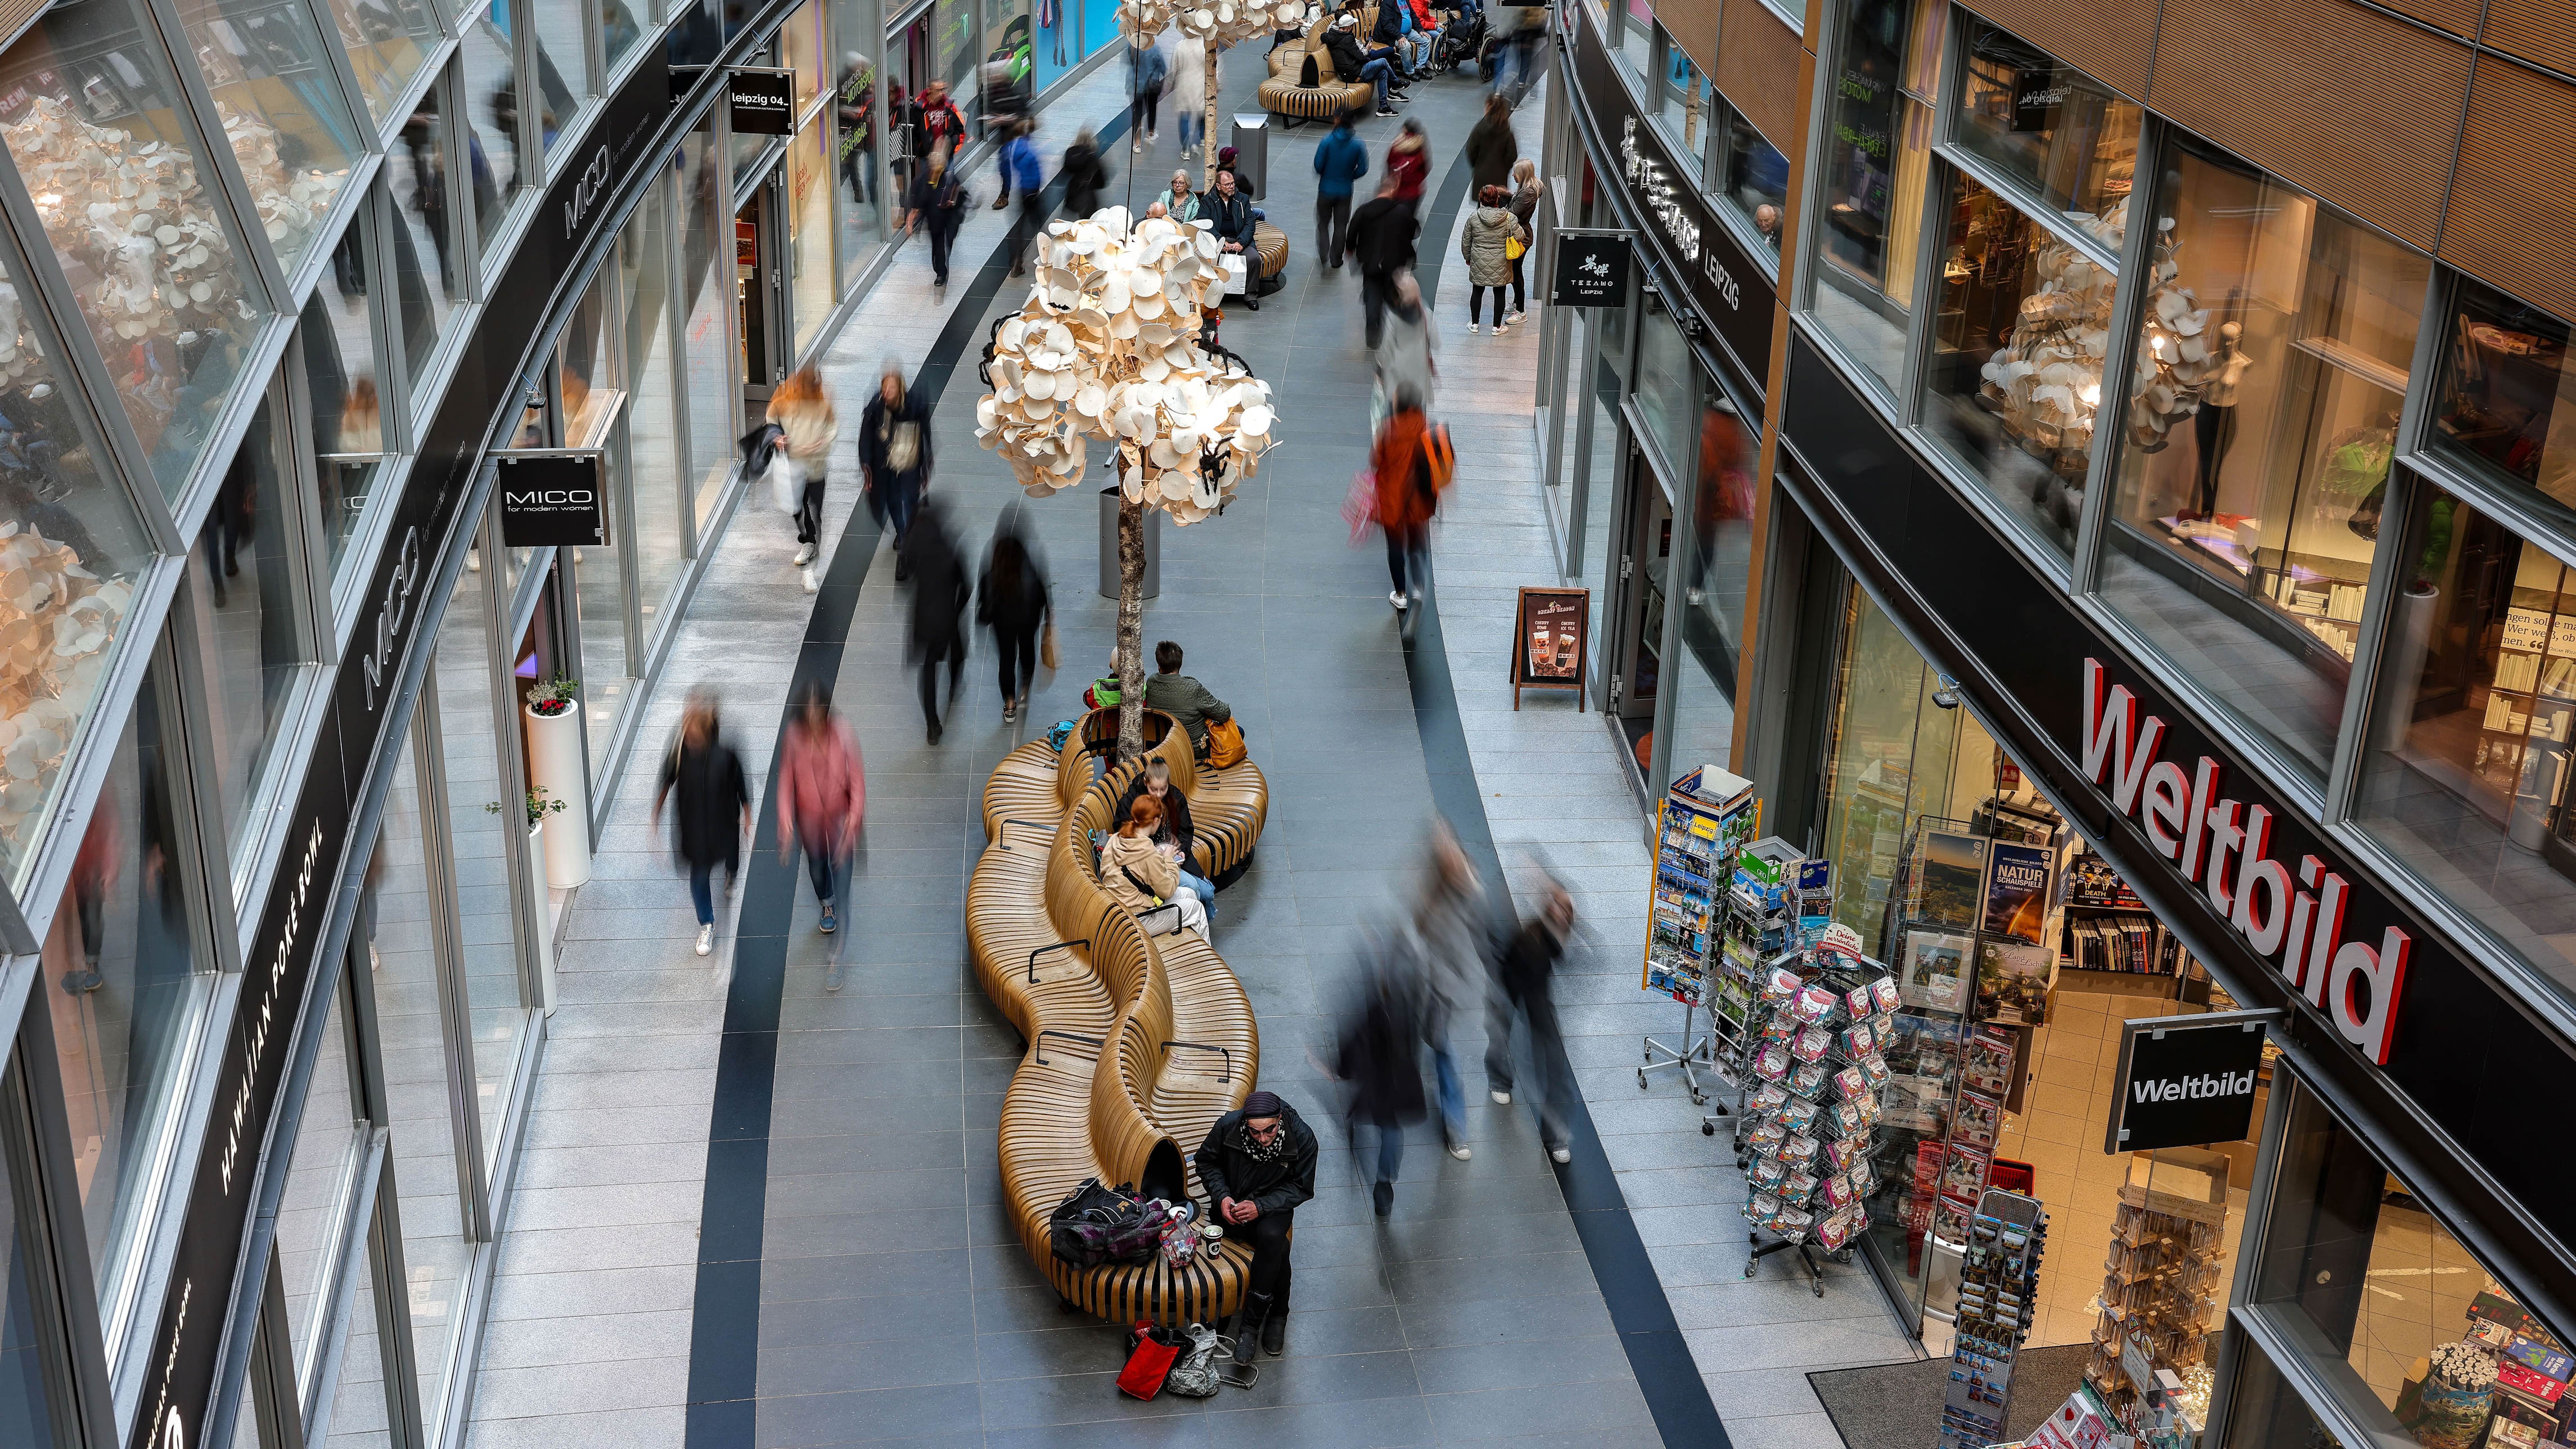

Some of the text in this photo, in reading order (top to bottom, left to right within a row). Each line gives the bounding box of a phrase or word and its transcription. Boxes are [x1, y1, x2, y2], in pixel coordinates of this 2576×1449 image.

[848, 64, 877, 105] MOTORSPORT
[732, 92, 768, 106] leipzig
[613, 112, 651, 166] for modern women
[840, 122, 867, 162] ERFAHRBAR
[796, 162, 808, 183] locally
[565, 144, 609, 240] MICO
[795, 179, 805, 201] happy
[1704, 248, 1739, 311] LEIPZIG
[422, 439, 466, 548] for modern women
[506, 490, 592, 504] MICO
[363, 525, 419, 711] MICO
[2533, 618, 2560, 628] sole
[2507, 624, 2575, 642] Wer weß, ob
[1694, 822, 1714, 834] Leipzig
[2083, 657, 2411, 1066] Weltbild
[1757, 868, 1767, 879] GEO
[1998, 864, 2044, 882] NATUR
[1997, 876, 2043, 889] SCHAUSPIELE
[1836, 930, 1857, 942] Deine
[1820, 941, 1861, 959] Weihnachtsgeschichte
[1826, 936, 1859, 951] persönliche
[2003, 951, 2025, 961] Land
[2021, 958, 2043, 968] Licht
[221, 816, 323, 1197] HAWAIIAN POKÉ BOWL
[1987, 1043, 2008, 1055] Weltbild
[1768, 1053, 1782, 1065] Emma
[1802, 1068, 1818, 1081] Jonas
[2134, 1070, 2254, 1103] Weltbild
[1766, 1087, 1780, 1100] Alina
[1793, 1100, 1811, 1116] Alexander
[1973, 1099, 1994, 1110] Weltbild
[1767, 1122, 1780, 1135] Alina
[1793, 1140, 1807, 1151] Anna
[1963, 1151, 1985, 1163] Weltbild
[1762, 1161, 1777, 1173] Daniel
[1795, 1175, 1809, 1186] David
[1759, 1196, 1772, 1207] Elias
[2131, 1187, 2201, 1210] Holzugelschreiber
[1785, 1208, 1799, 1220] Emily
[1948, 1204, 1969, 1216] Weltbild
[178, 1276, 192, 1330] BOWL
[2549, 1362, 2562, 1375] Karten
[2540, 1385, 2553, 1397] Karten
